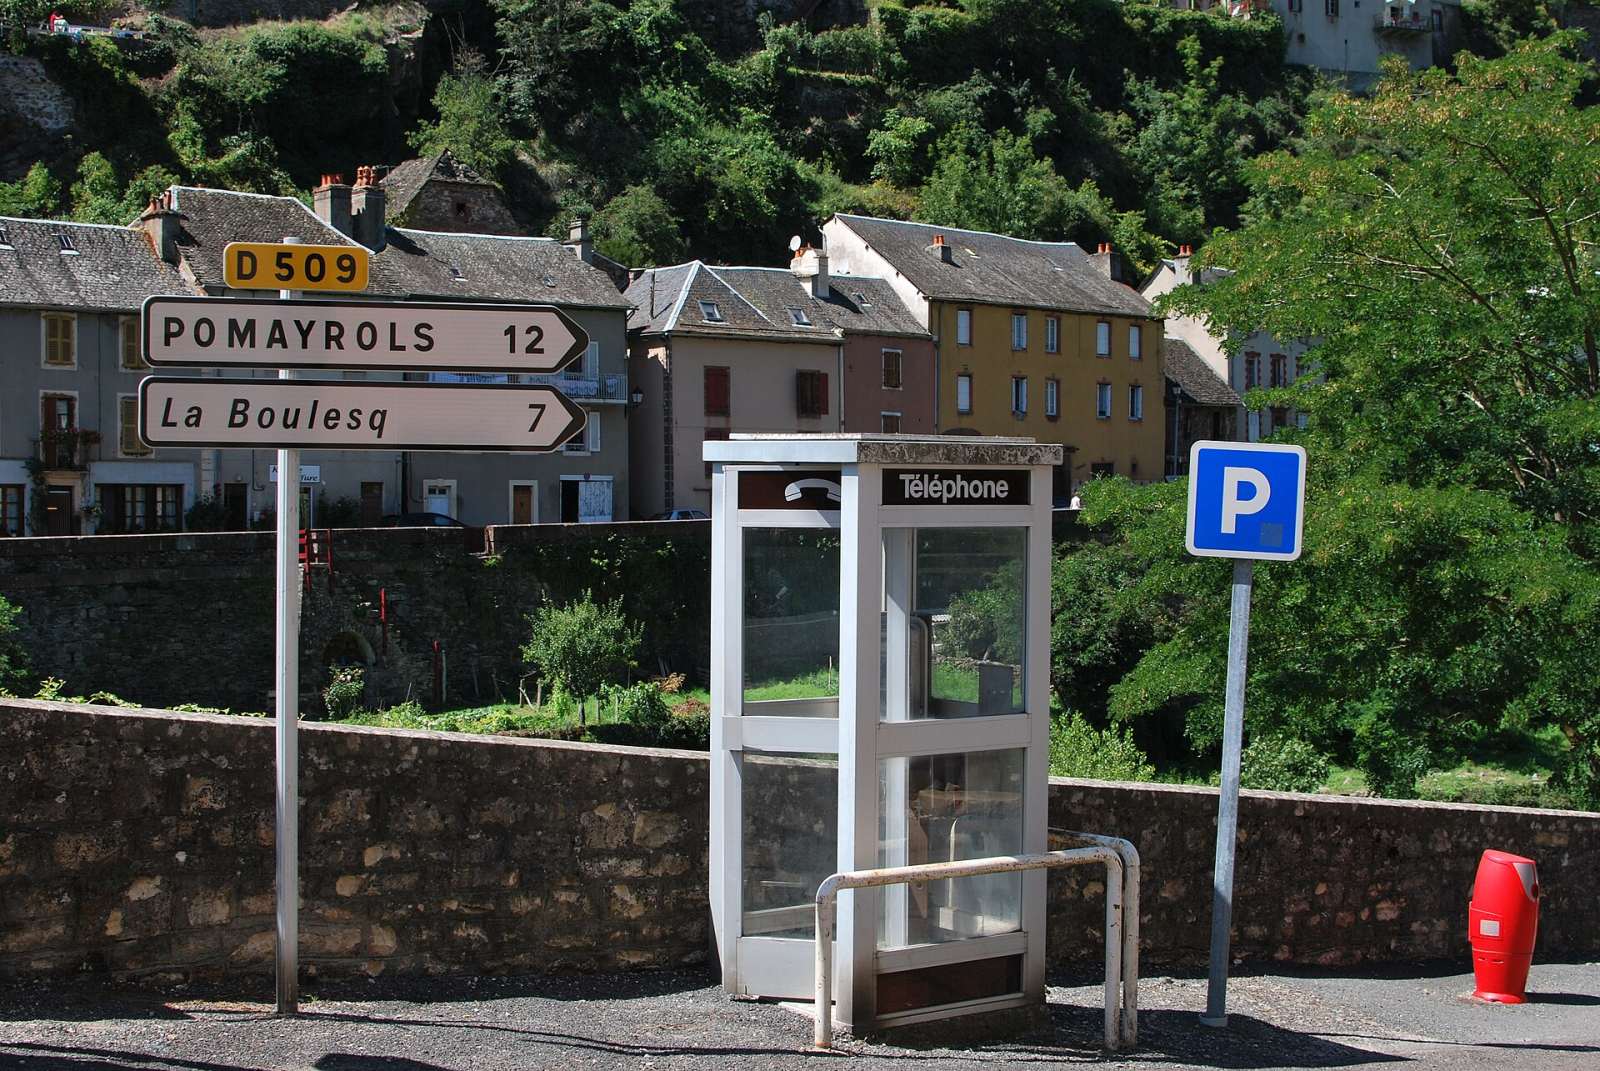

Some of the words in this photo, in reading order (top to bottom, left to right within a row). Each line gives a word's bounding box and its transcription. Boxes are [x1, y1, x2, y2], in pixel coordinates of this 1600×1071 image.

[237, 250, 257, 281] D
[275, 251, 357, 284] 509
[164, 316, 435, 353] POMAYROLS
[504, 325, 545, 355] 12
[161, 397, 203, 428] La
[228, 399, 388, 439] Boulesq
[528, 403, 547, 433] 7
[899, 473, 1009, 504] Téléphone
[1221, 466, 1271, 534] P
